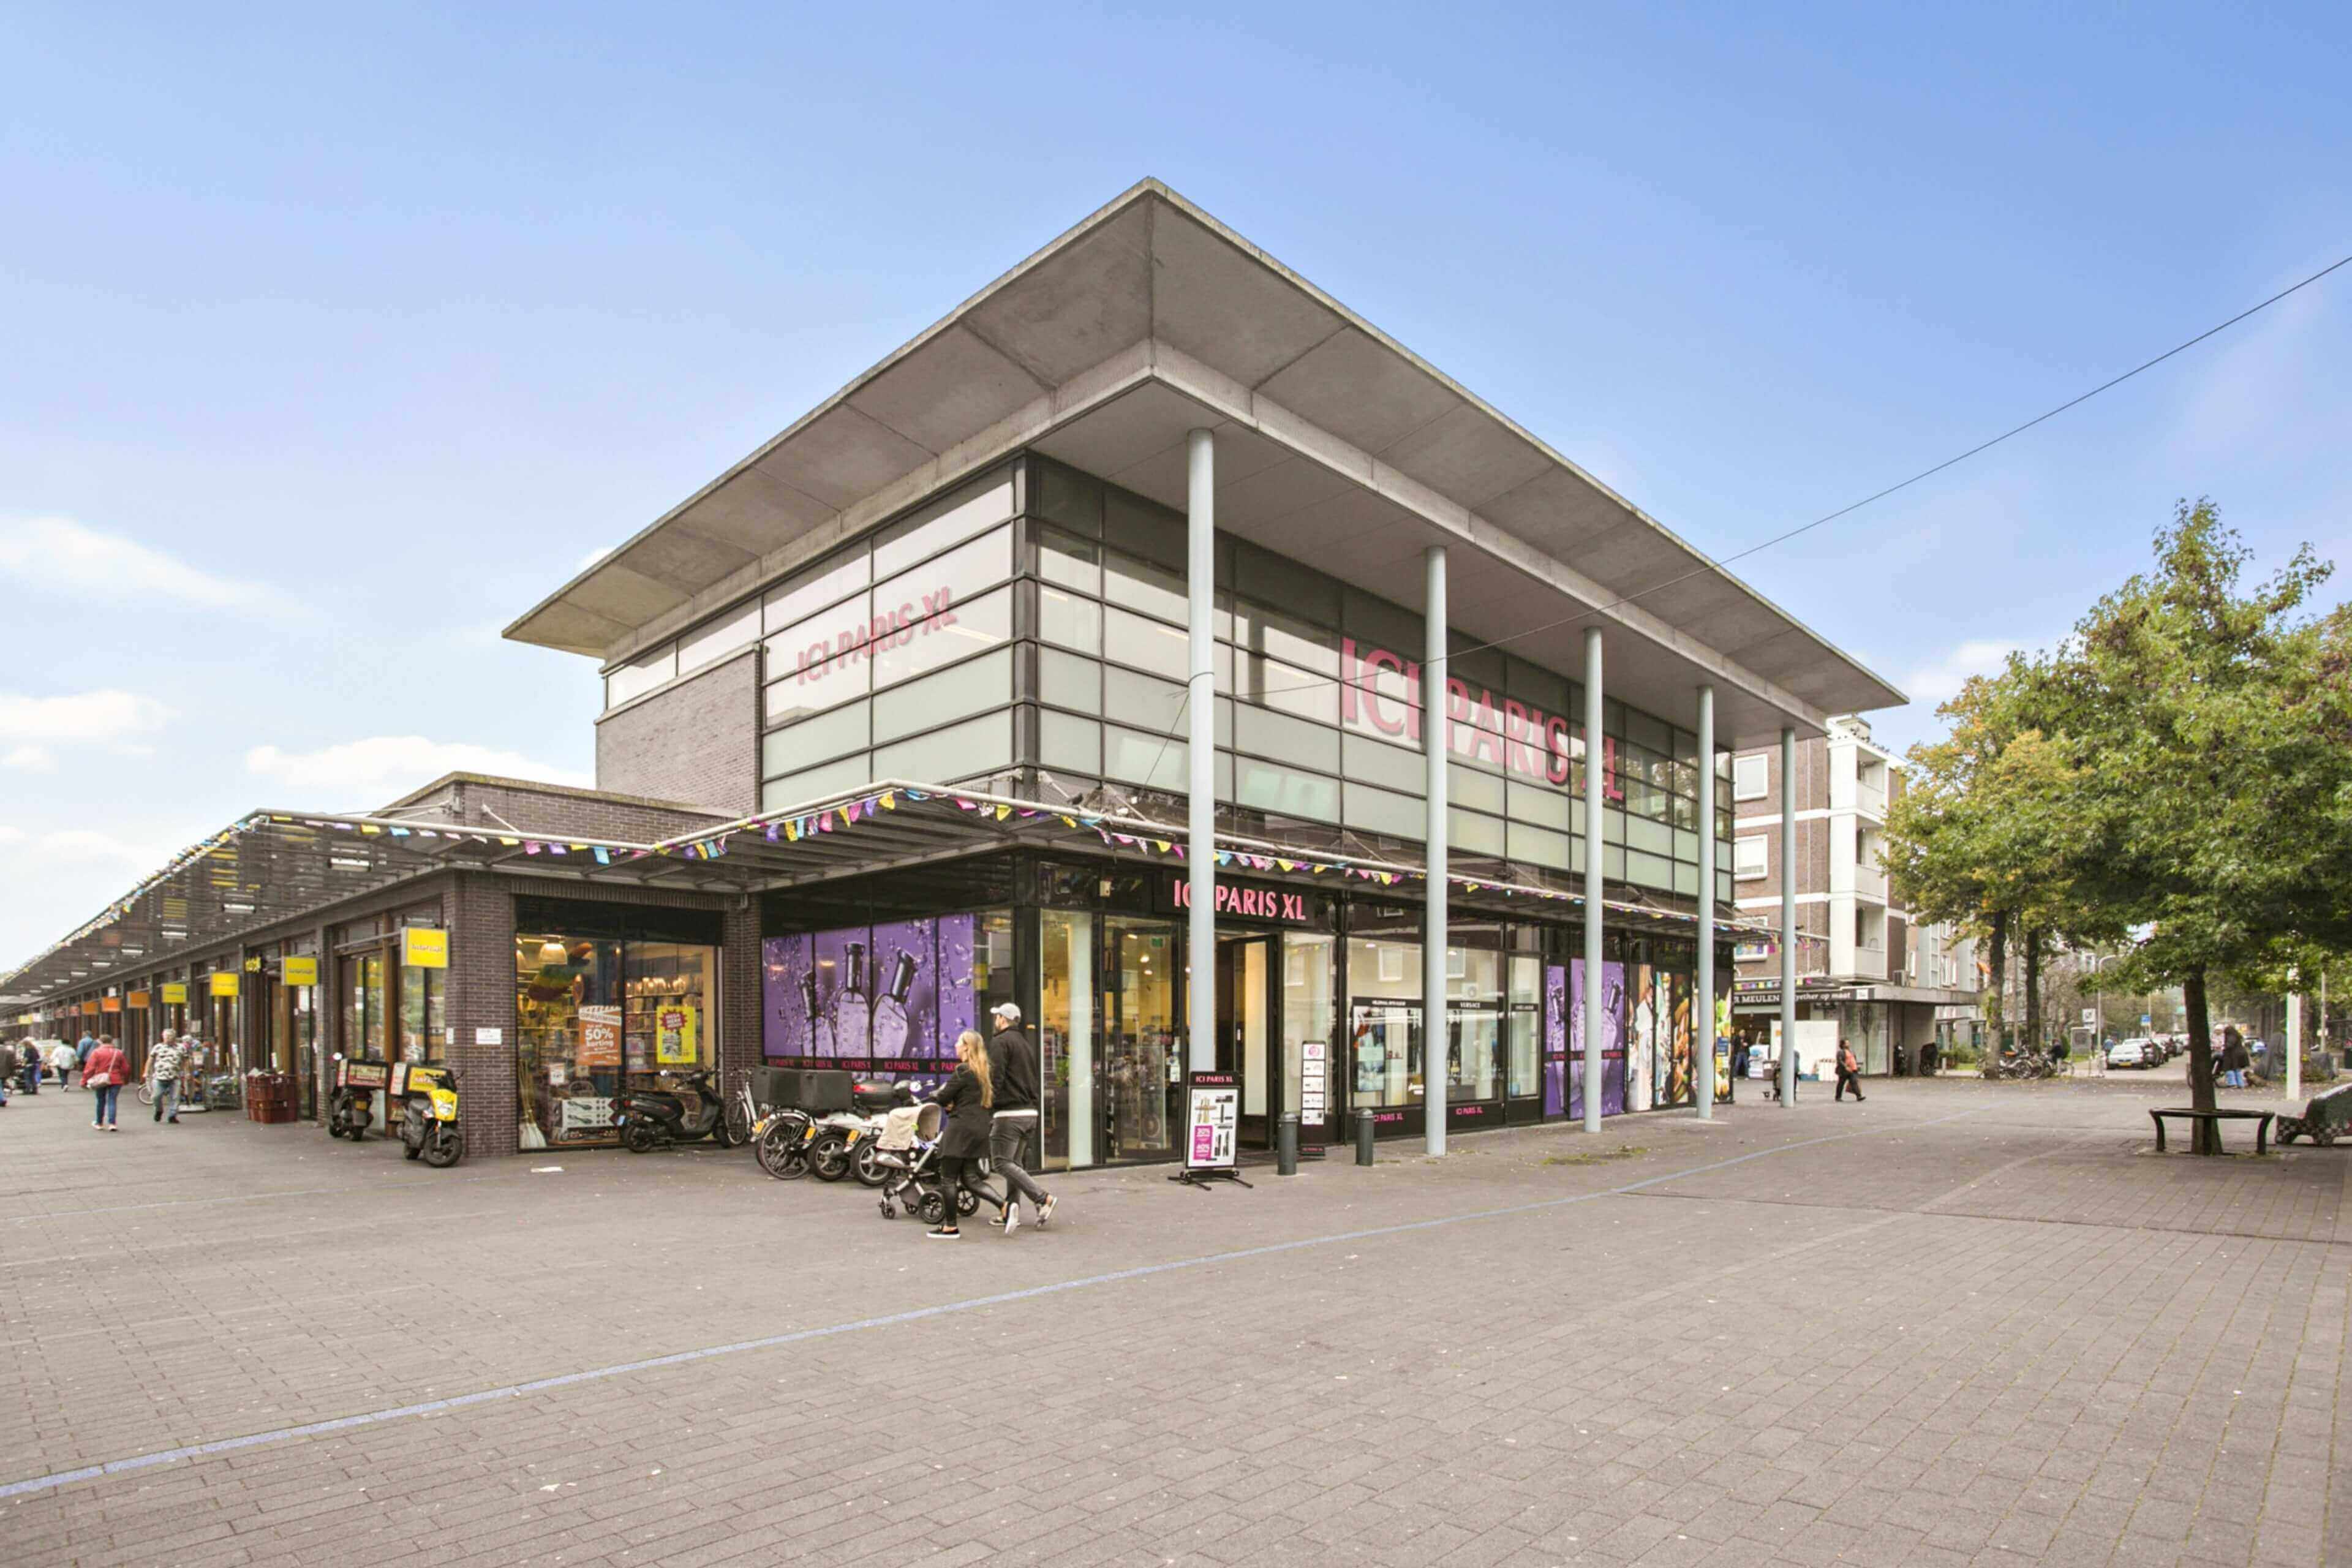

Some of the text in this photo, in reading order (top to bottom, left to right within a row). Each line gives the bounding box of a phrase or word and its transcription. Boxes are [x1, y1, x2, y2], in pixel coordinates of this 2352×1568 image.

[797, 586, 959, 687] ICI PARIS XL
[1341, 637, 1421, 739] ICI
[1447, 677, 1569, 785] PARIS
[1174, 879, 1306, 921] IC PARIS XL
[1742, 994, 1780, 1003] MEULEN
[585, 1027, 614, 1040] 50%
[884, 1060, 919, 1071] ICI PARIS XL
[1206, 1075, 1225, 1084] PARIS
